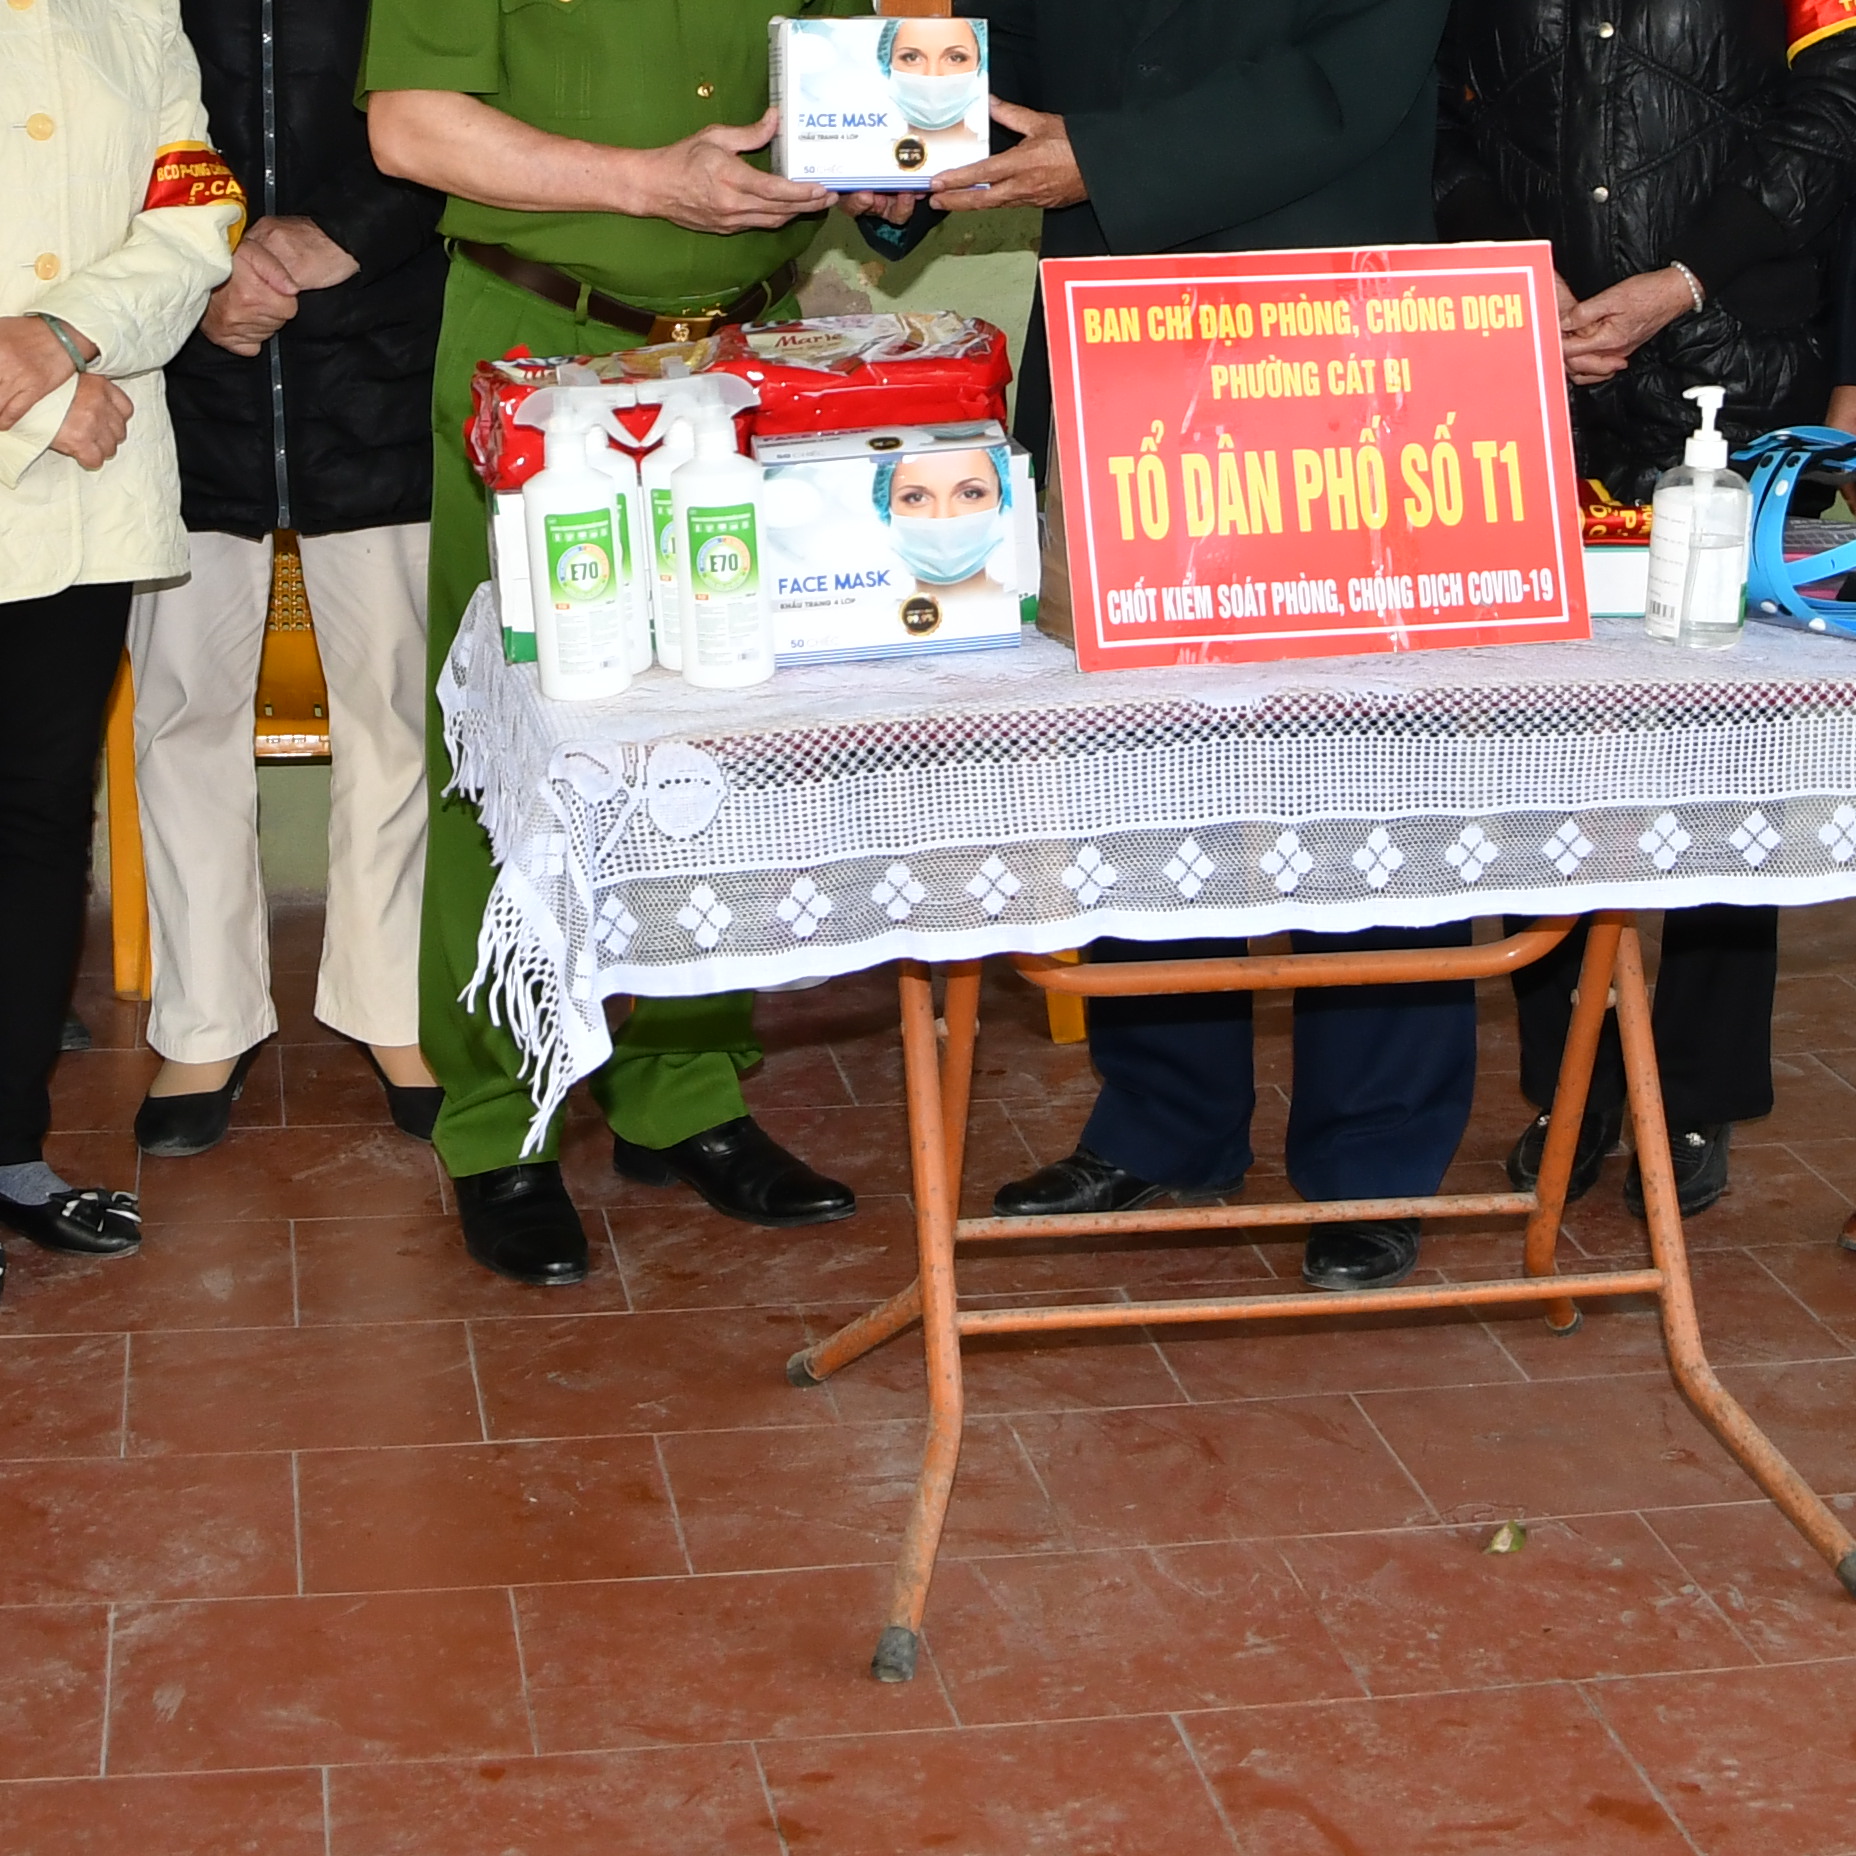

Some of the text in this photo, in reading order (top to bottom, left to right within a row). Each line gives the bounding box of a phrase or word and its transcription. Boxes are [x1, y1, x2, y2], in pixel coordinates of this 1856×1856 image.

[797, 113, 889, 128] FACE MASK
[1083, 284, 1524, 347] BAN CHỈ ĐẠO PHÒNG, CHỐNG DỊCH
[1210, 354, 1412, 400] PHƯỜNG CÁT BI
[1109, 419, 1171, 541] TỔ
[1181, 432, 1284, 538] DÂN
[1291, 413, 1390, 532] PHỐ
[1401, 412, 1463, 529] SỐ
[570, 561, 599, 582] E70
[709, 553, 739, 573] E70
[778, 569, 892, 595] FACE MASK
[1106, 575, 1158, 626] CHỐT
[1162, 571, 1214, 622] KIỂM
[1218, 572, 1267, 619] SOÁT
[1272, 571, 1346, 618] PHÒNG,
[1419, 573, 1464, 616] DỊCH
[1468, 568, 1554, 606] COVID-19
[790, 639, 805, 649] 50
